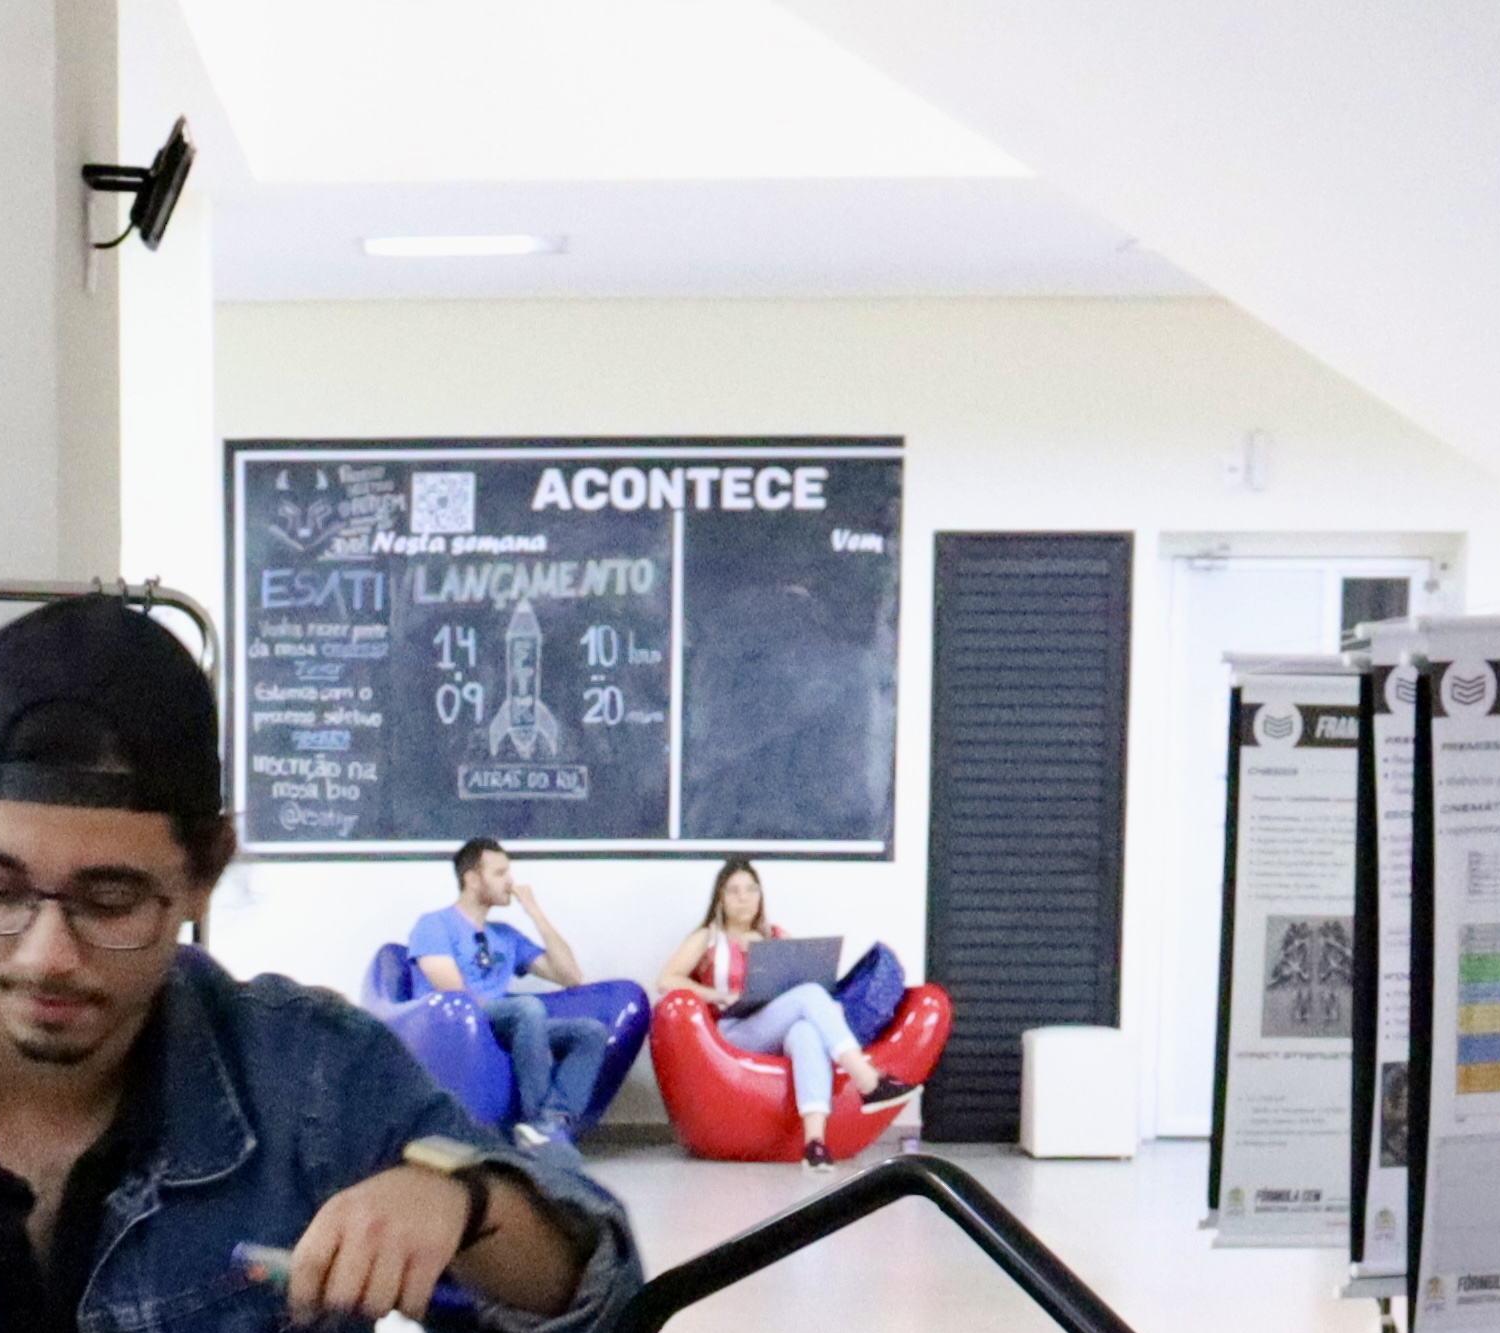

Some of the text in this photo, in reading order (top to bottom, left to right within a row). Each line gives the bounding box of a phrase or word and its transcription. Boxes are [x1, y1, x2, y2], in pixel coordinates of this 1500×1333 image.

[532, 466, 829, 511] ACONTECE
[371, 530, 548, 556] Nesta semana
[830, 529, 884, 554] Vem
[412, 557, 654, 610] LANÇAMENTO
[433, 625, 476, 669] 14
[580, 625, 619, 667] 10
[436, 682, 484, 725] 09
[582, 685, 624, 726] 20
